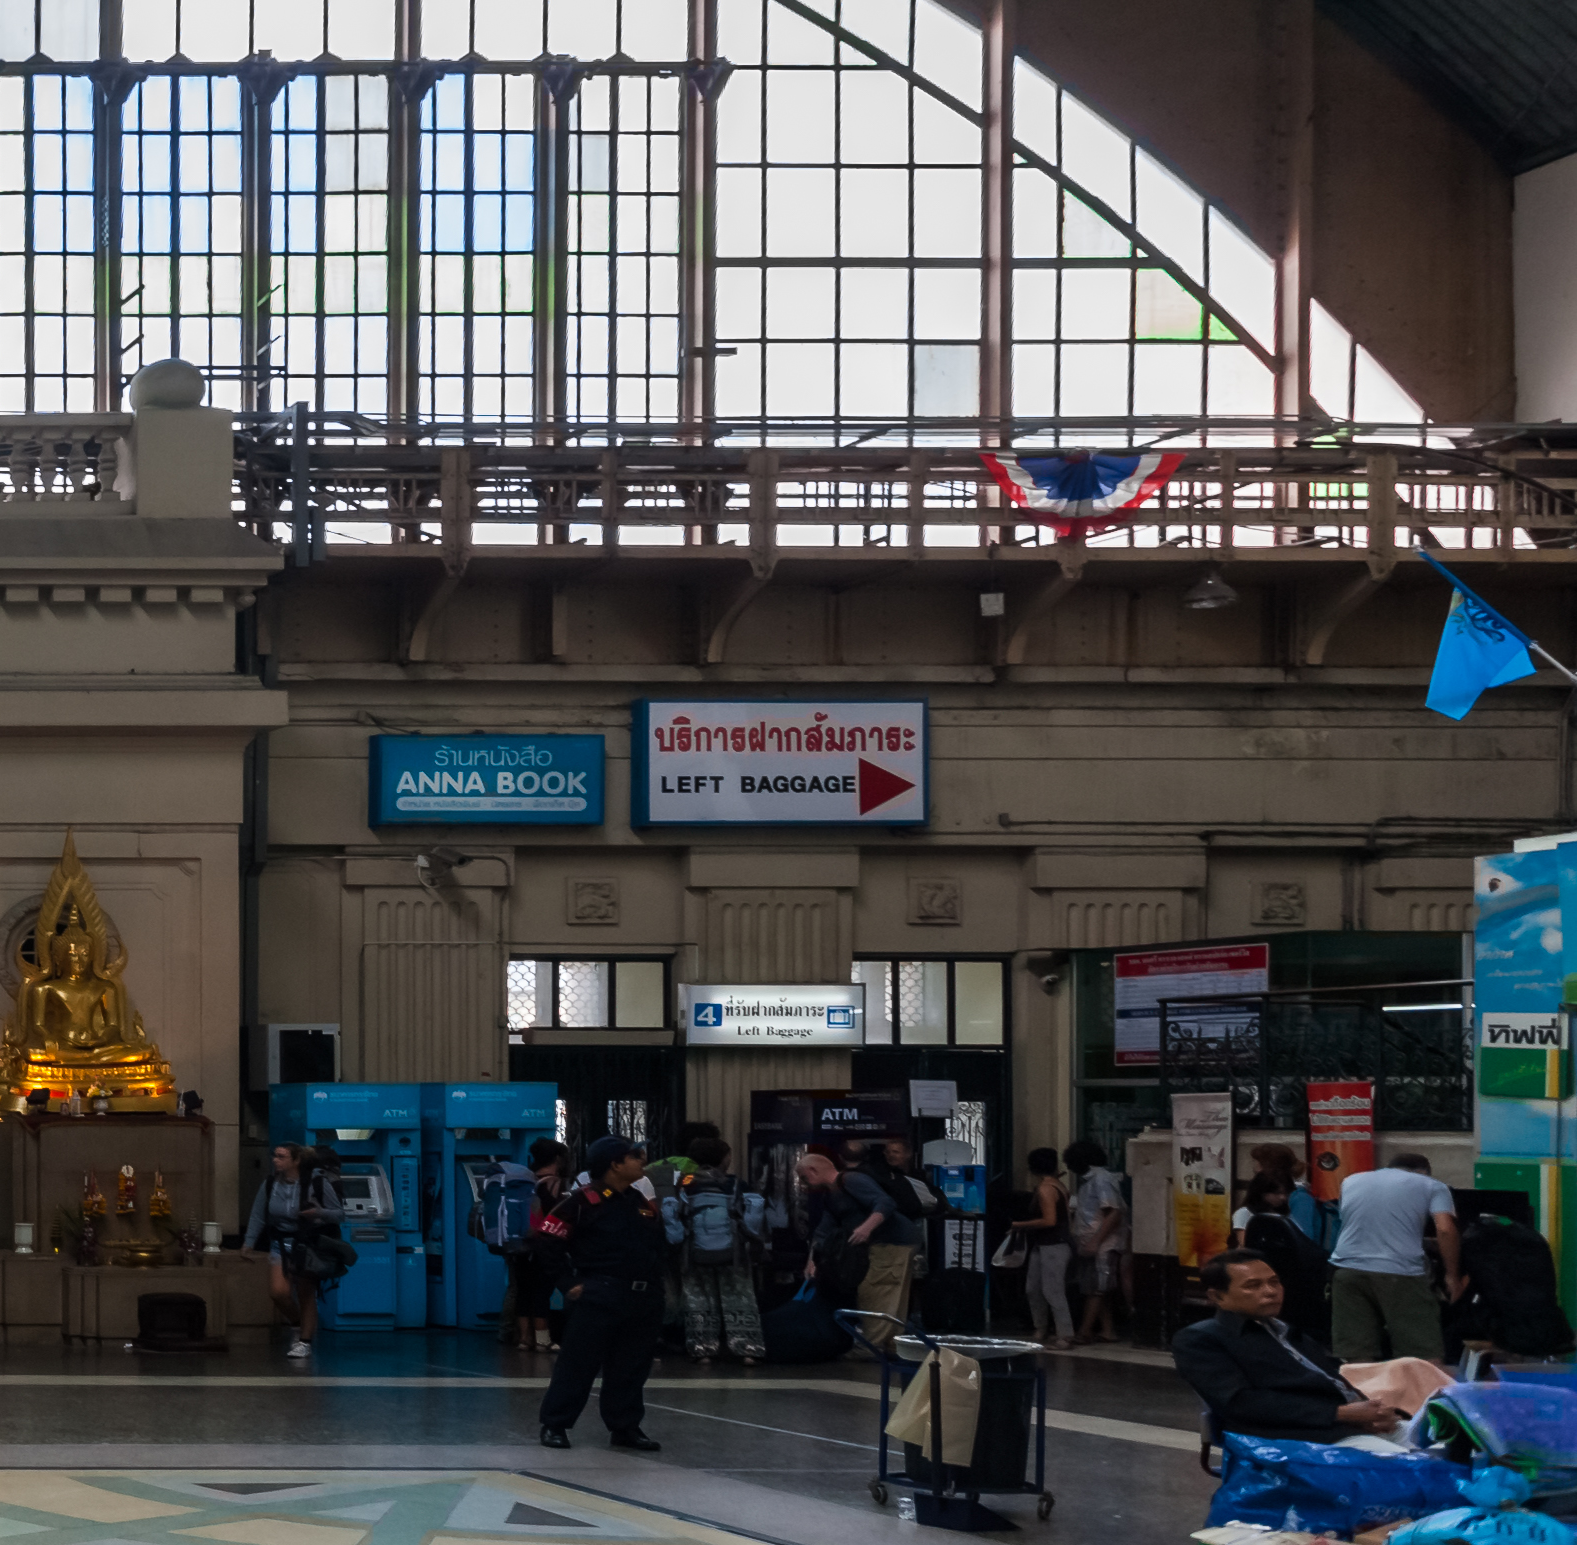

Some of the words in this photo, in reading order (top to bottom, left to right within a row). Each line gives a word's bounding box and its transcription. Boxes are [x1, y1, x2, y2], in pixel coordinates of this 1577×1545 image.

[655, 712, 916, 753] บริการฝากสัมภาระ
[435, 745, 553, 766] ร้านหนังสือ
[396, 771, 486, 794] ANNA
[496, 771, 587, 795] BOOK
[661, 776, 724, 793] LEFT
[740, 776, 856, 794] BAGGAGE
[696, 1005, 717, 1025] 4
[724, 995, 825, 1018] ที่รับฝากสัมภาระ
[737, 1026, 761, 1036] Left
[766, 1026, 814, 1039] Baggage
[383, 1109, 408, 1117] ATM
[521, 1109, 545, 1117] ATM
[821, 1108, 859, 1121] ATM
